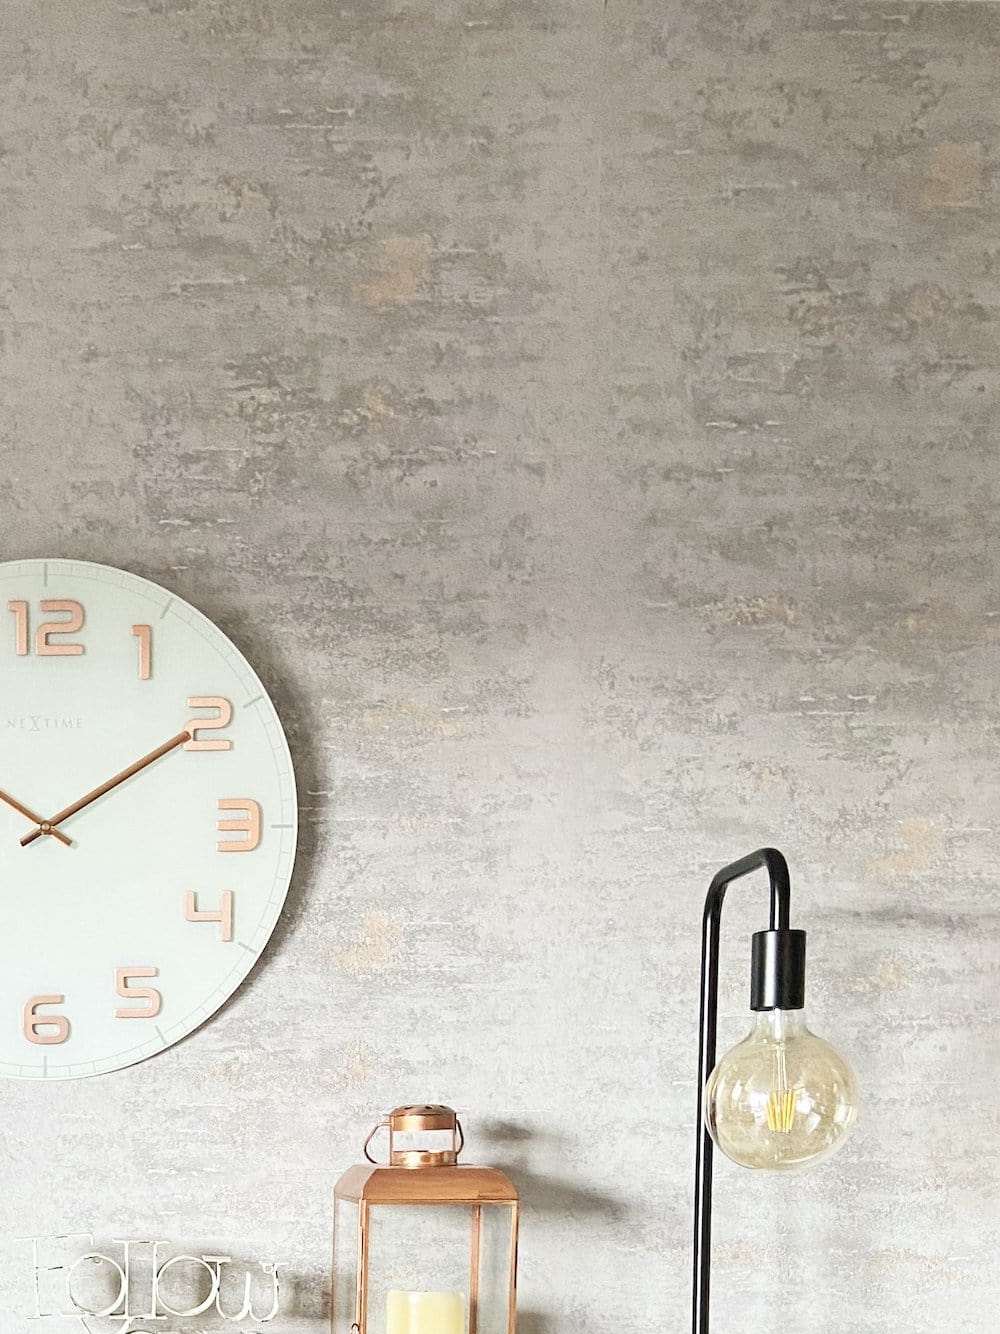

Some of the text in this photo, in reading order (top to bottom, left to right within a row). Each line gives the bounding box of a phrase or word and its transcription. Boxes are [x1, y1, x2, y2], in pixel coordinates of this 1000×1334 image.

[8, 600, 85, 656] 12
[132, 625, 153, 680] 1
[183, 697, 232, 751] 2
[217, 799, 263, 852] 3
[184, 890, 234, 942] 4
[114, 967, 161, 1018] 5
[23, 995, 70, 1045] 6
[15, 1233, 289, 1322] Follow
